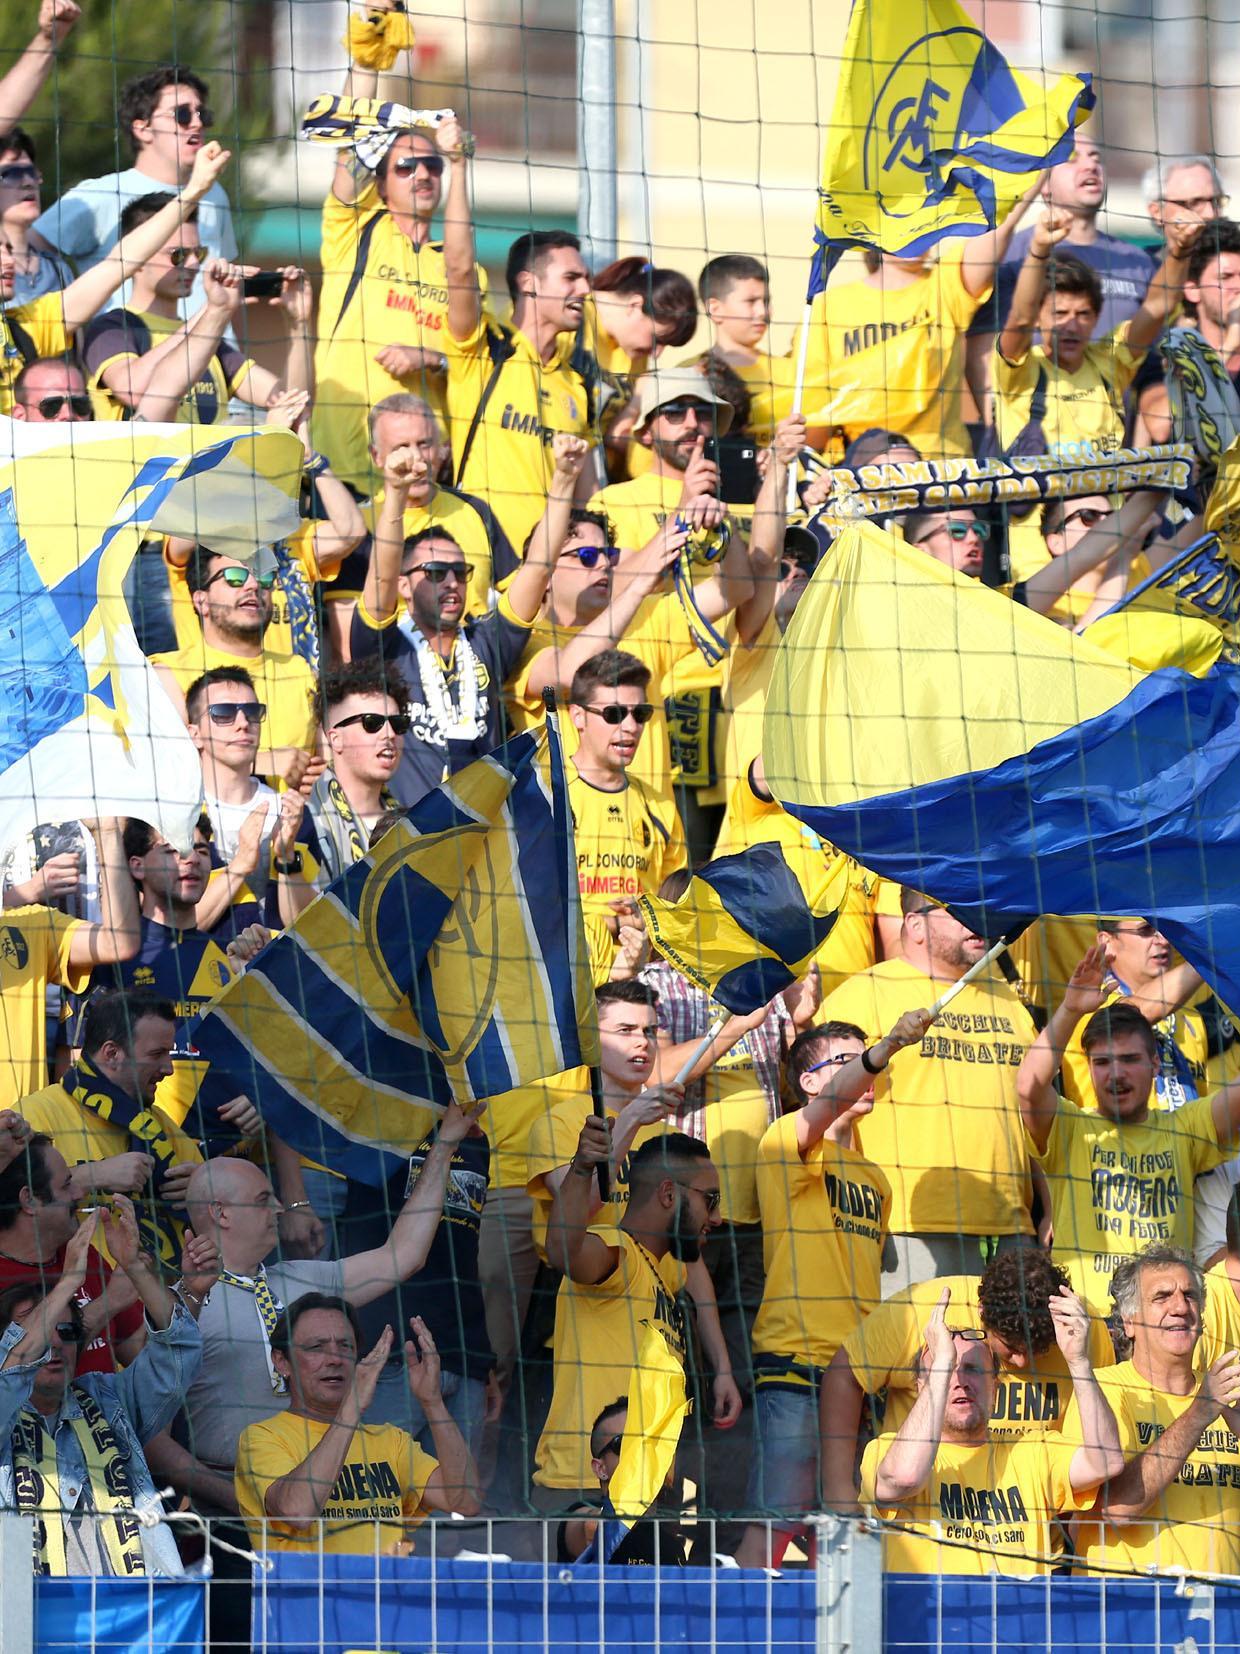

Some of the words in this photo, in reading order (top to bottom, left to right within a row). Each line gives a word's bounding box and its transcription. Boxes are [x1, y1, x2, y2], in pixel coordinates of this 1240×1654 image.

[859, 461, 934, 490] SAM
[924, 481, 993, 507] SAM
[995, 475, 1041, 503] DA
[1045, 459, 1191, 498] RISPETER
[919, 1035, 1025, 1067] BRIGATE
[1092, 1144, 1117, 1168] PER
[1091, 1167, 1179, 1220] MODENA
